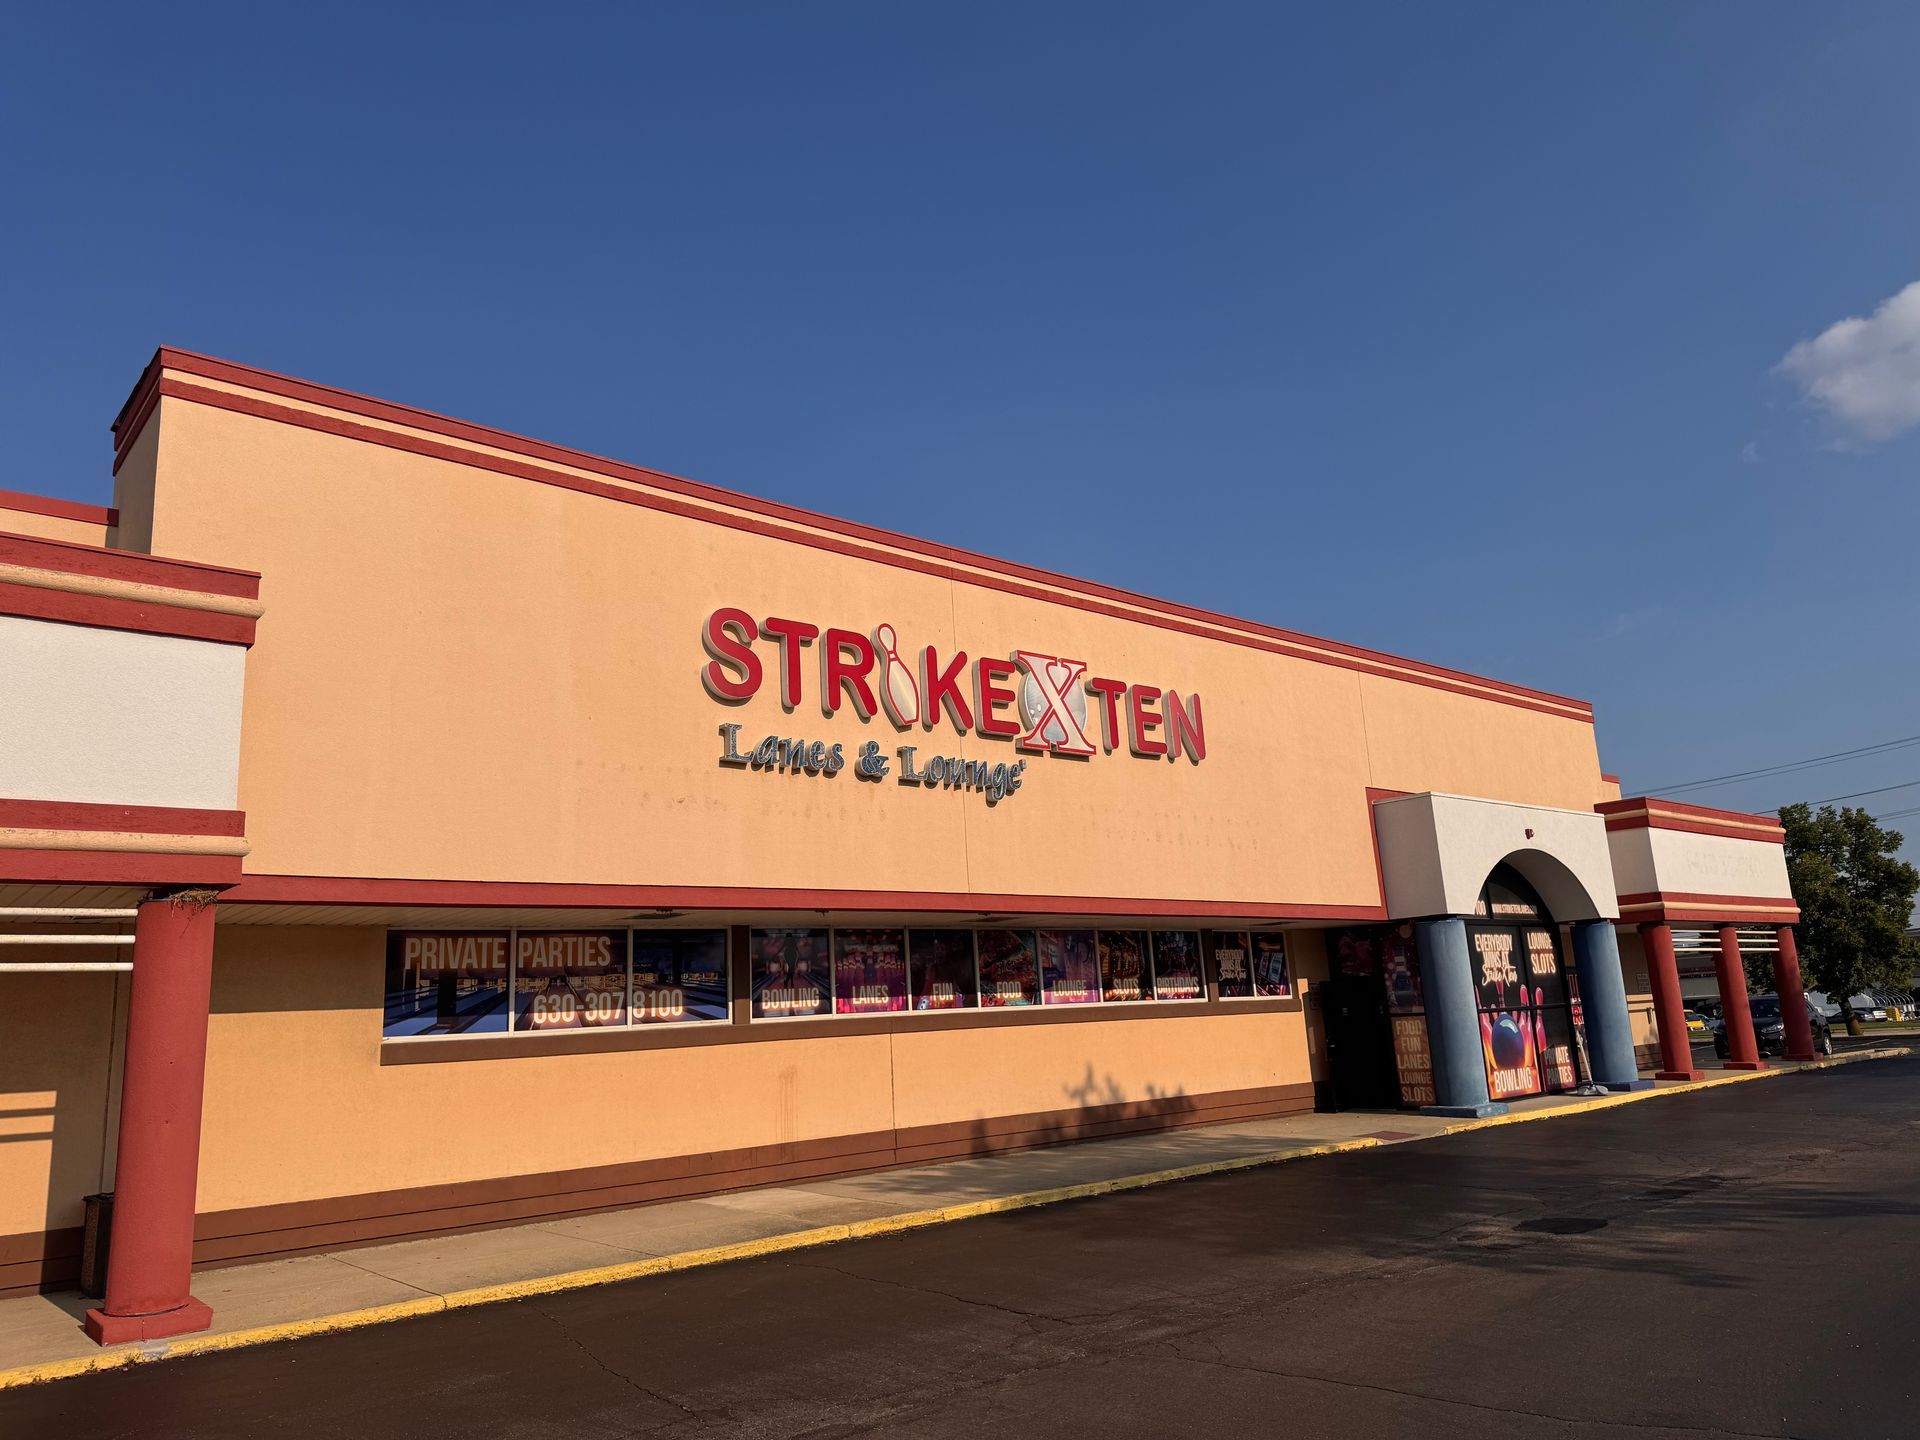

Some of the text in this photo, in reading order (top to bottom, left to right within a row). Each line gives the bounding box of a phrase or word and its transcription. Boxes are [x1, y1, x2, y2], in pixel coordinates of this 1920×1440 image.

[719, 723, 1027, 804] Lanes & Lounge
[1474, 934, 1512, 951] EVERYBODY
[1527, 933, 1553, 950] LOUNGE
[404, 936, 611, 970] PRIVATE PARTIES
[1482, 951, 1510, 967] WINS AT
[1530, 953, 1556, 974] SLOTS
[932, 982, 953, 1001] FUN
[996, 981, 1022, 999] FOOD
[1053, 979, 1088, 997] LOUNGE
[1113, 977, 1140, 995] SLOTS
[1156, 976, 1200, 994] BIRTHDAYS
[761, 987, 820, 1010] BOWLING
[852, 984, 889, 1005] LANES
[1395, 1020, 1422, 1035] FOOD
[1401, 1037, 1421, 1052] FUN
[1397, 1054, 1430, 1069] LANES
[1543, 1046, 1570, 1064] PRIVATE
[1399, 1071, 1432, 1085] LOUNGE
[1494, 1067, 1532, 1093] BOWLING
[1546, 1066, 1573, 1085] PARTIES
[1402, 1086, 1434, 1102] SLOTS
